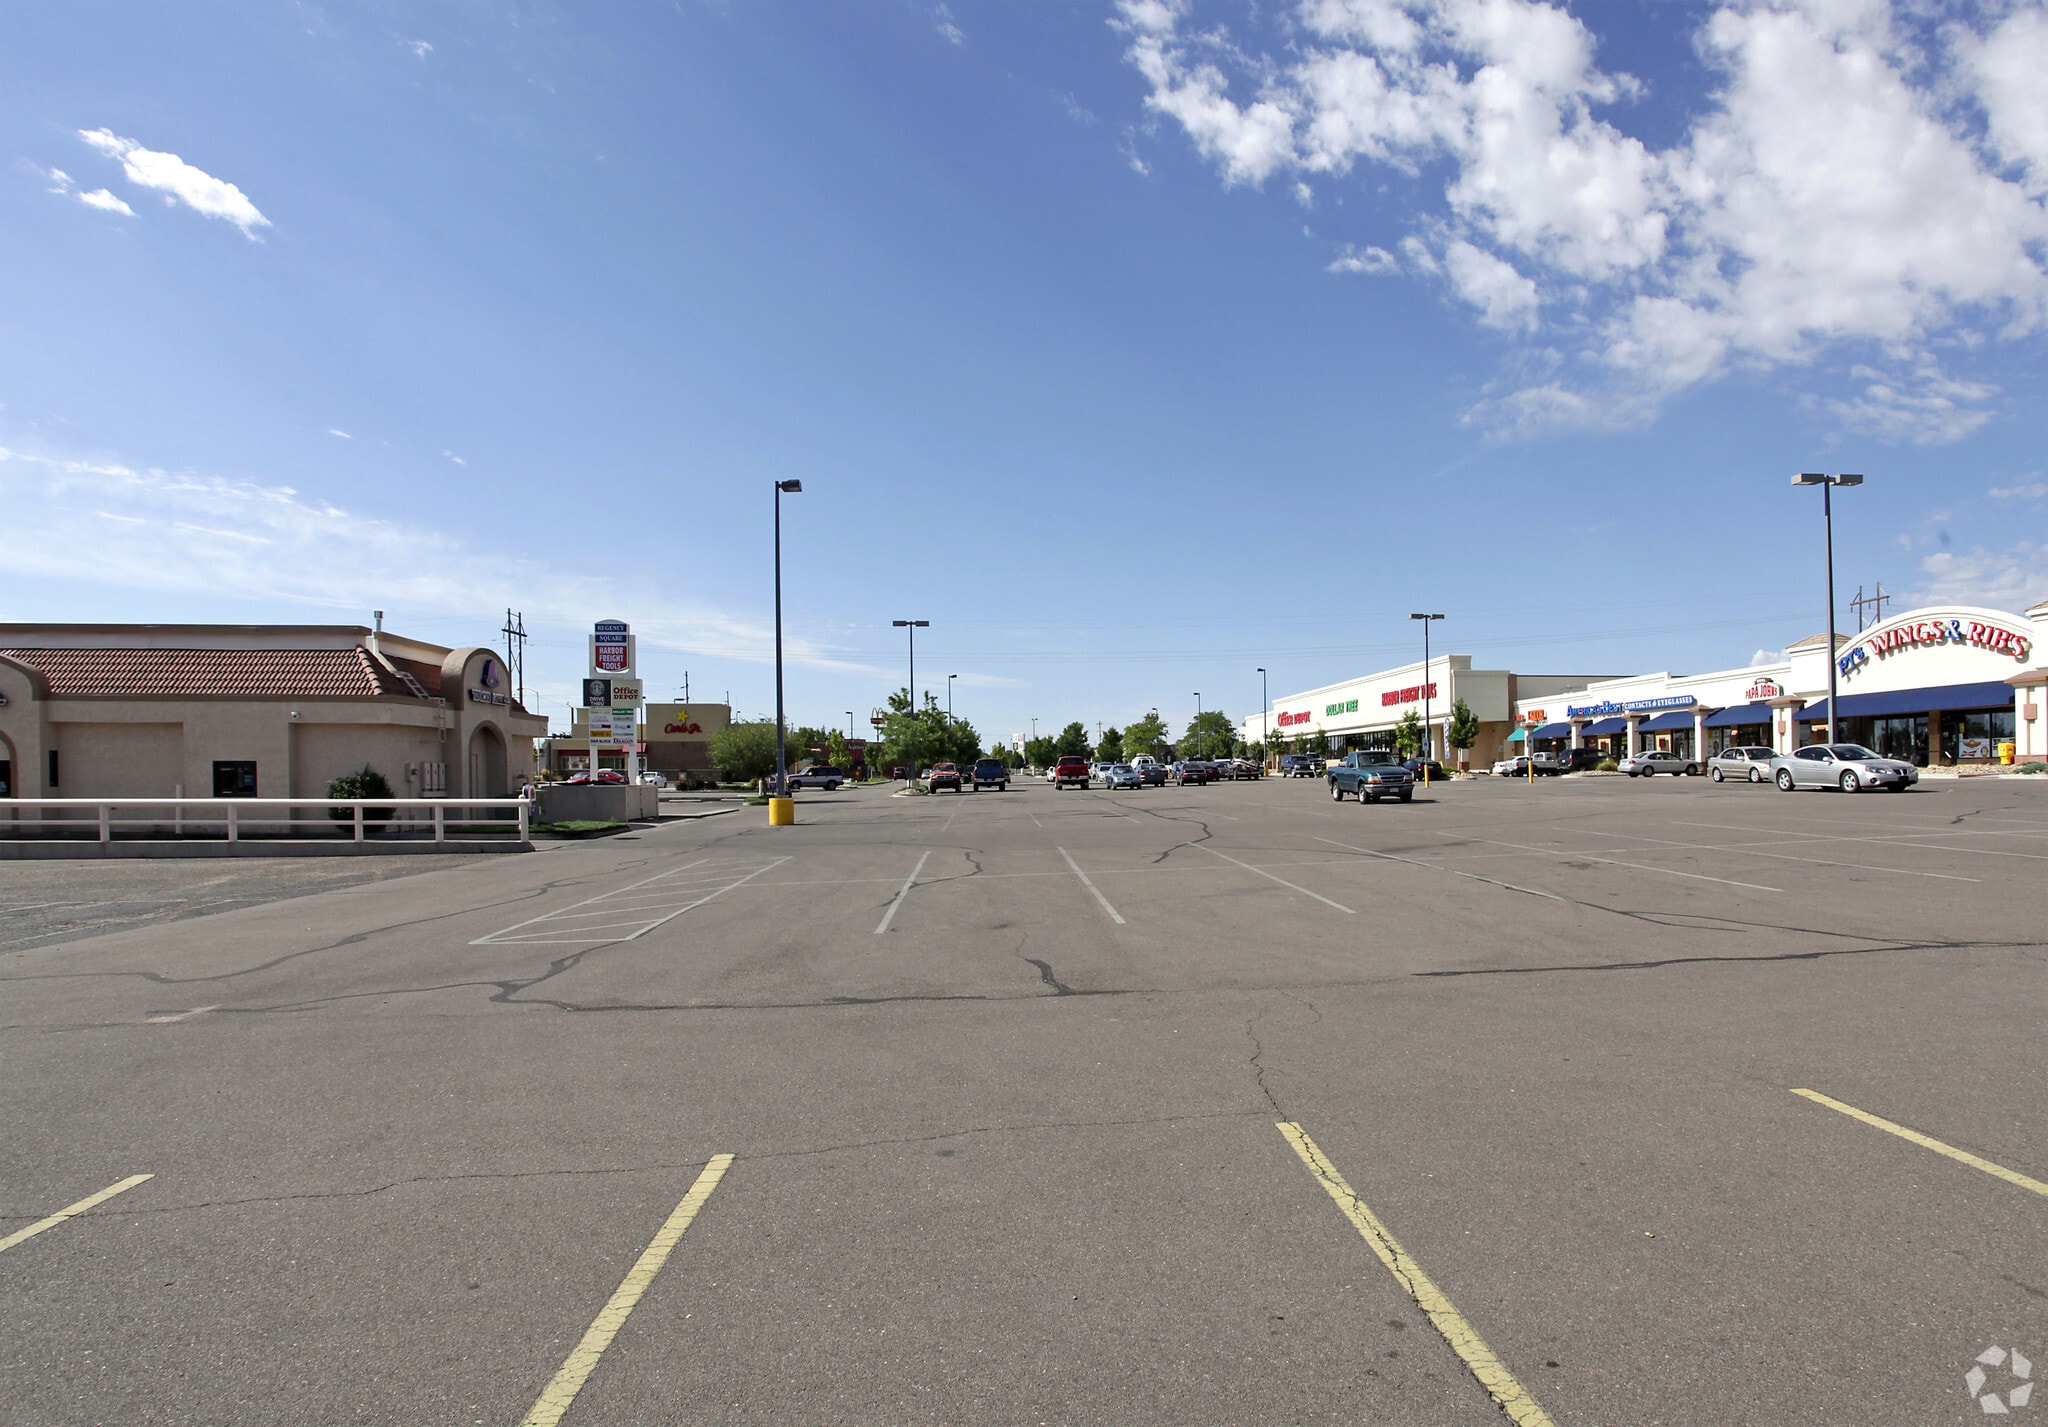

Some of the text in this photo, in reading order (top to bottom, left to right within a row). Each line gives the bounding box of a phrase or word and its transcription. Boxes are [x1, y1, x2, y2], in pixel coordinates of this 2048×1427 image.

[1867, 621, 1944, 655] WINGS
[1945, 620, 1961, 639] &
[1966, 621, 2027, 656] RIB'S
[602, 662, 621, 670] TOOLS
[613, 687, 639, 695] Office
[1745, 685, 1760, 700] PAPA
[1326, 699, 1359, 717] DOLLAR TREE
[1624, 700, 1652, 711] CONTACTS
[1657, 695, 1693, 707] EYEGLASSES
[1277, 711, 1311, 727] Office DEPOT
